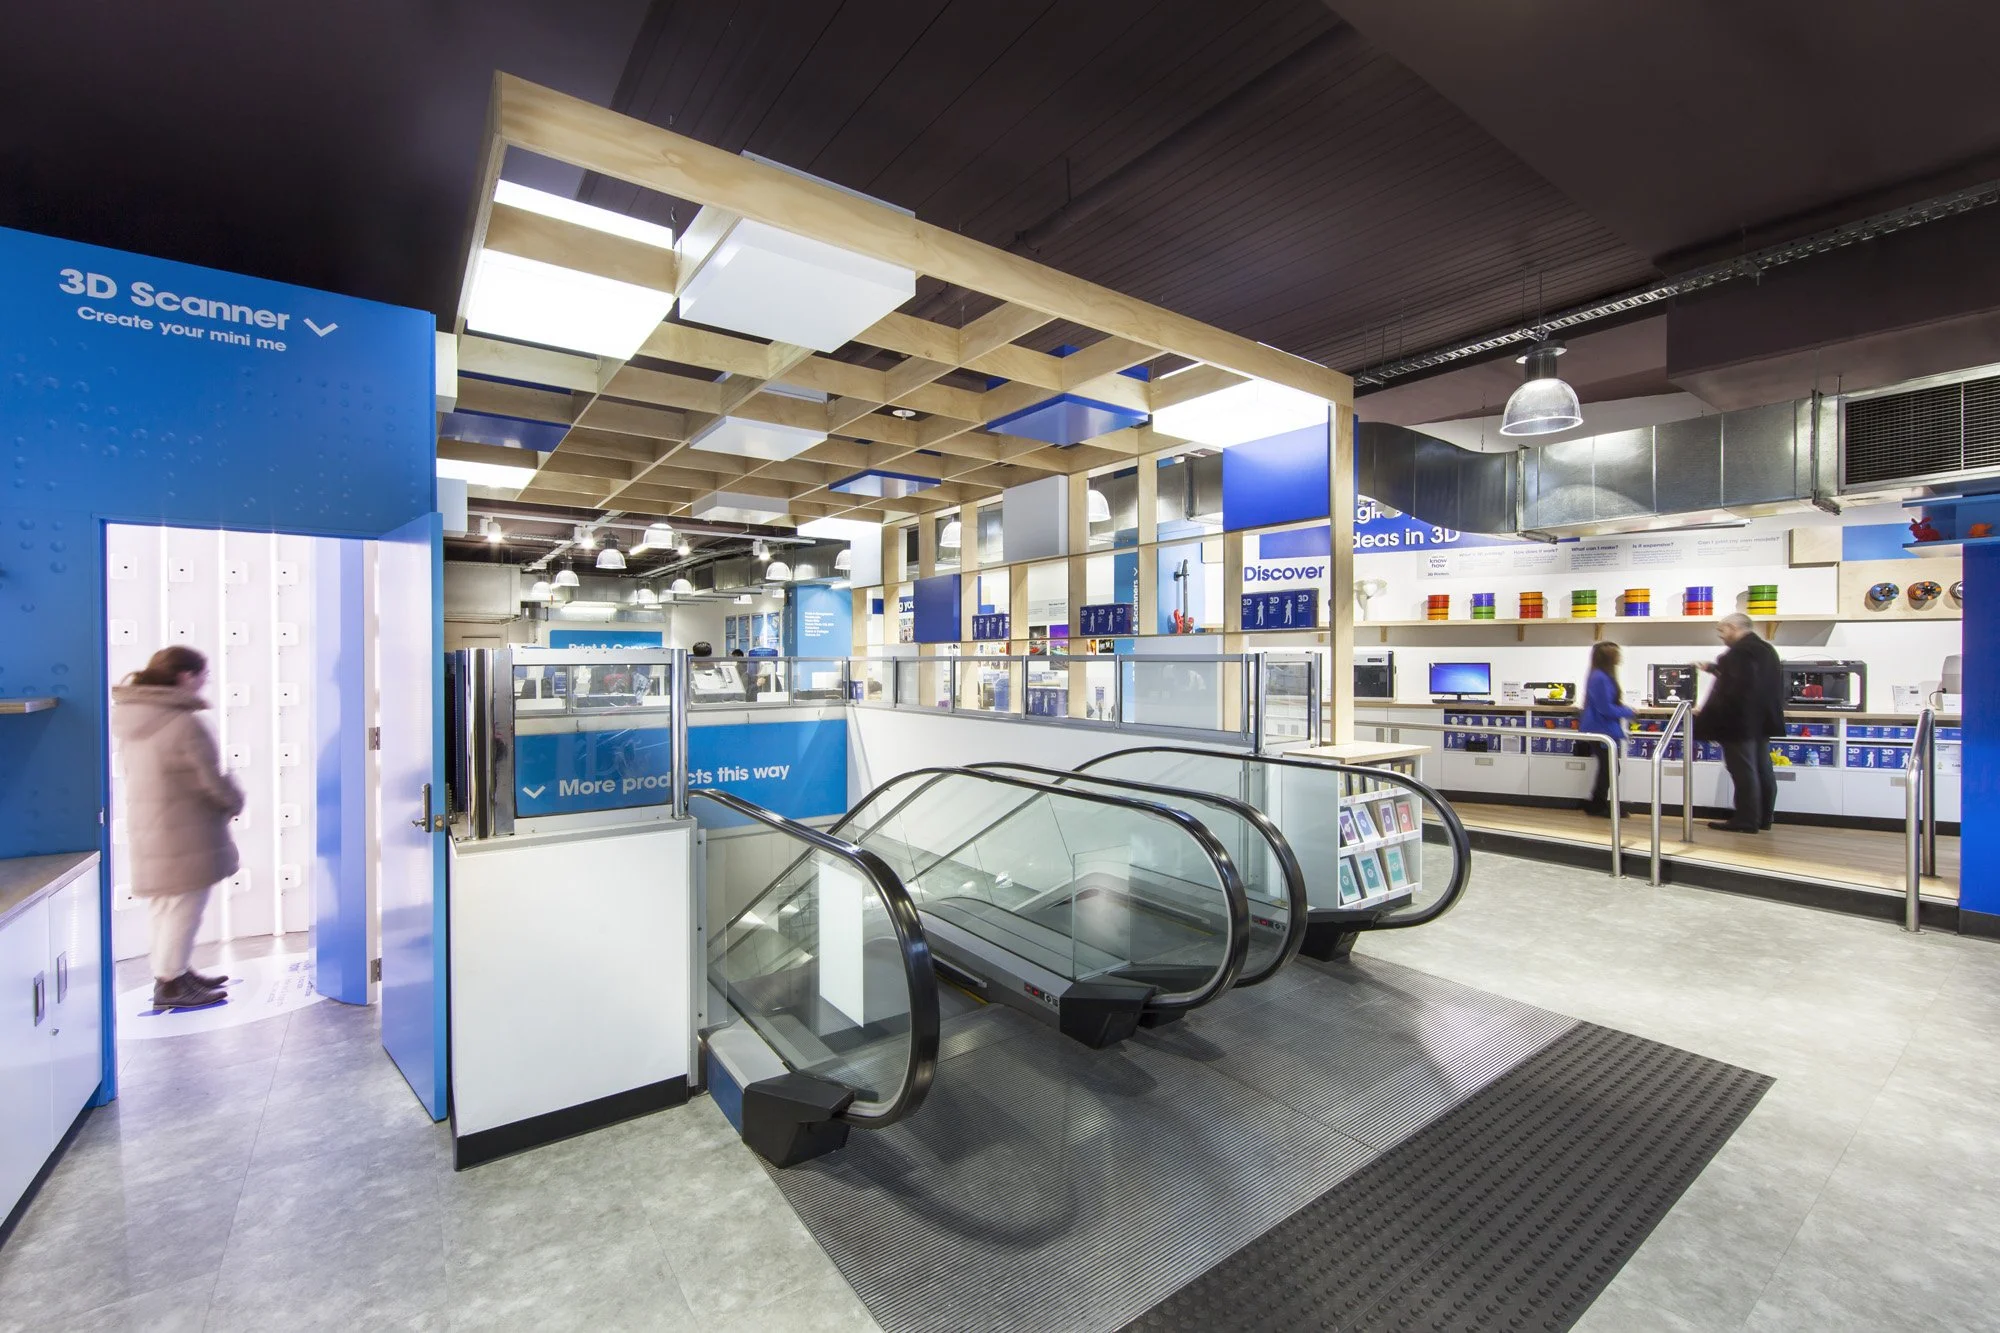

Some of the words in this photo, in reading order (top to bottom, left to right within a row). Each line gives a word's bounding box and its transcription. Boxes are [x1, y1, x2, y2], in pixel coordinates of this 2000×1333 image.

[59, 268, 118, 300] 3D
[130, 281, 291, 331] Scanner
[77, 306, 154, 331] Create
[159, 321, 205, 340] your
[209, 328, 251, 347] mini
[256, 337, 287, 352] me
[1405, 528, 1424, 545] in
[1431, 526, 1461, 544] 3D
[1243, 565, 1325, 582] Discover
[1242, 598, 1253, 606] 3D
[1269, 596, 1280, 605] 3D
[1297, 594, 1309, 603] 3D
[1116, 607, 1124, 615] 3D
[559, 778, 616, 797] More
[622, 769, 713, 795] prodcts
[717, 766, 749, 783] this
[753, 764, 790, 781] way
